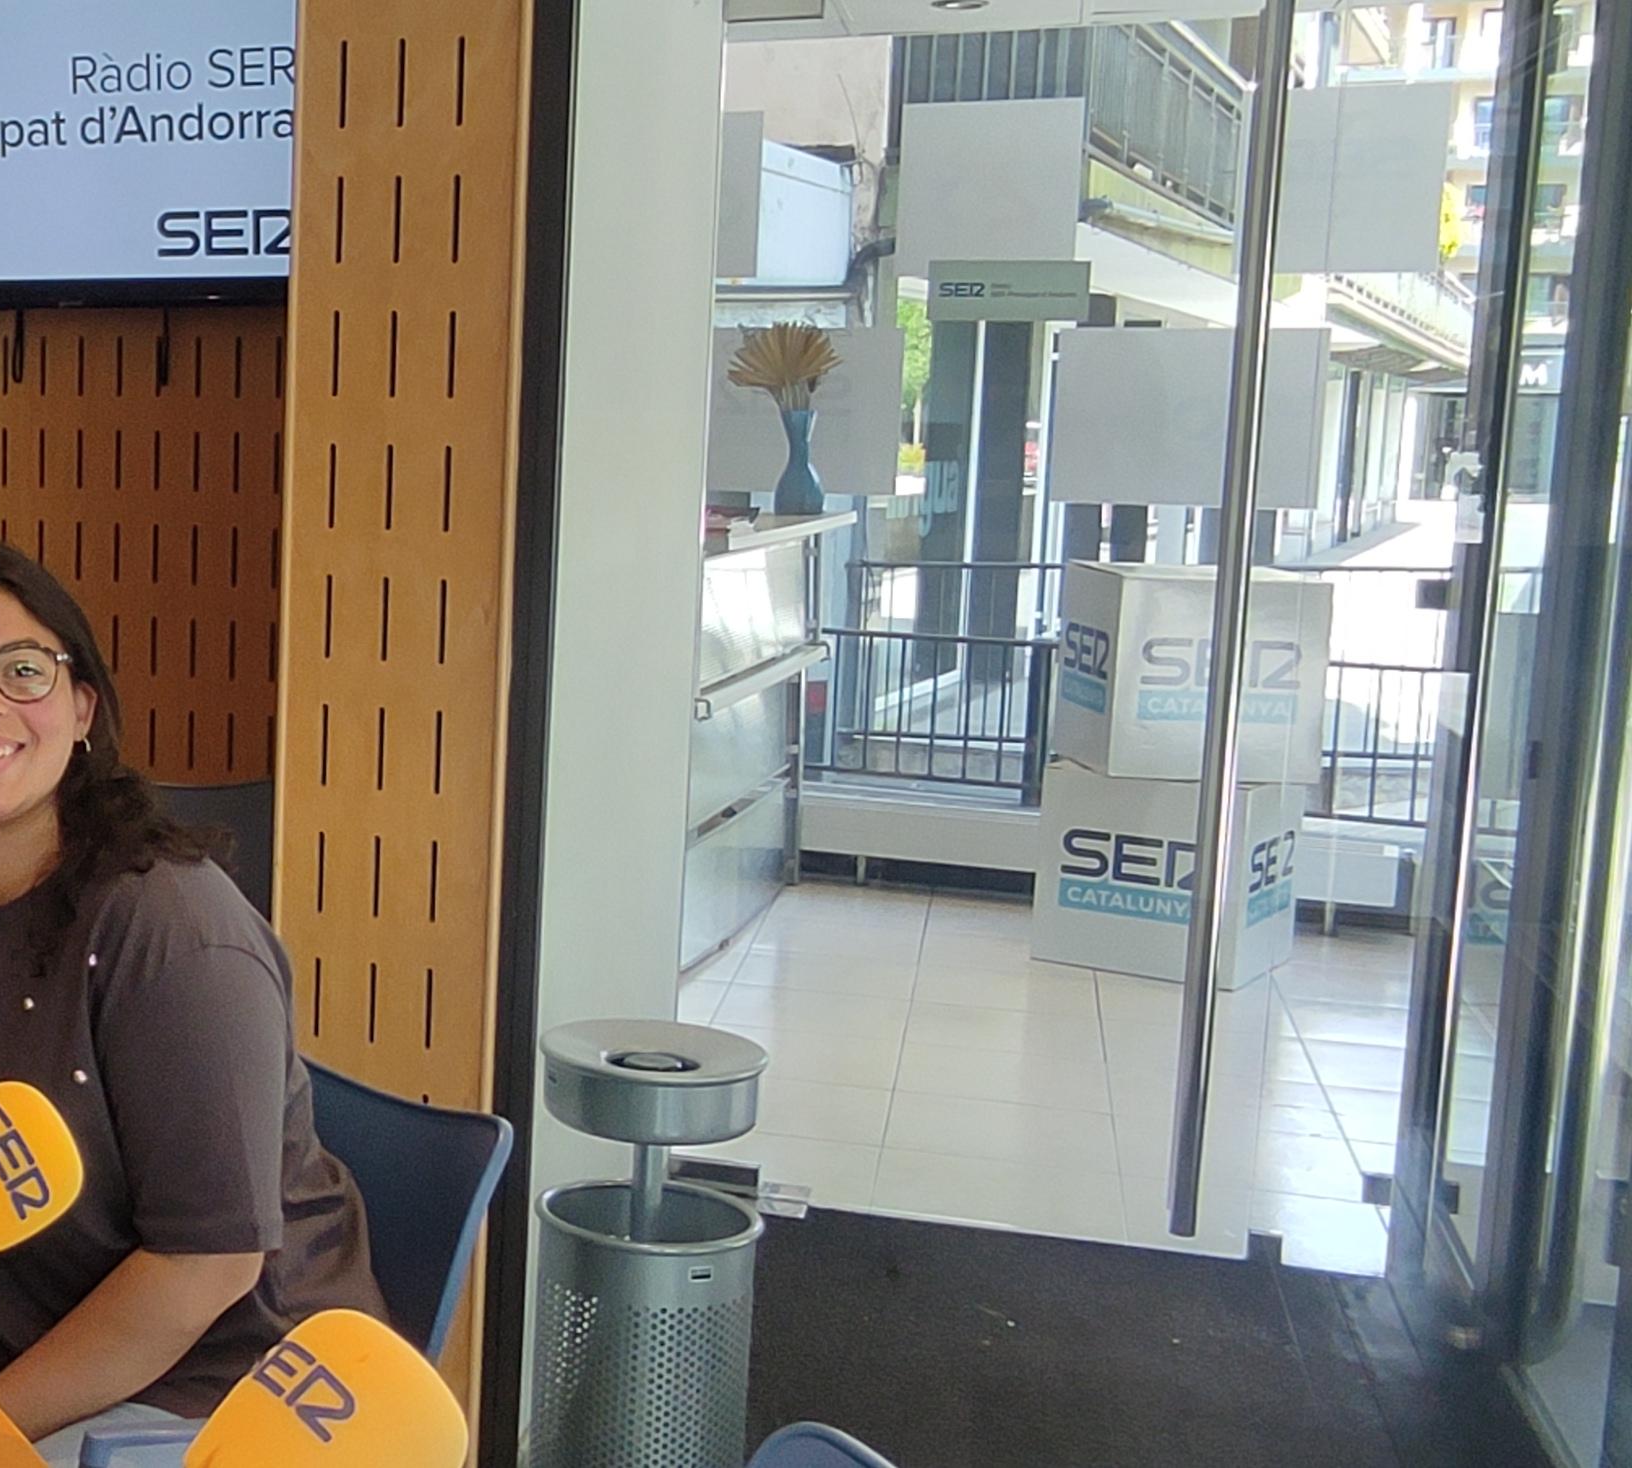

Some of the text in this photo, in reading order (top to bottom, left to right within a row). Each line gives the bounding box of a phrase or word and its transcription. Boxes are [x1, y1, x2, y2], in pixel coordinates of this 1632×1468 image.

[71, 47, 295, 94] Ràdio SER
[157, 209, 292, 257] SER
[939, 282, 985, 297] SER
[1064, 622, 1109, 680] SER
[1140, 637, 1302, 689] SR
[1067, 886, 1192, 920] CATALUNY
[251, 1340, 355, 1443] ER
